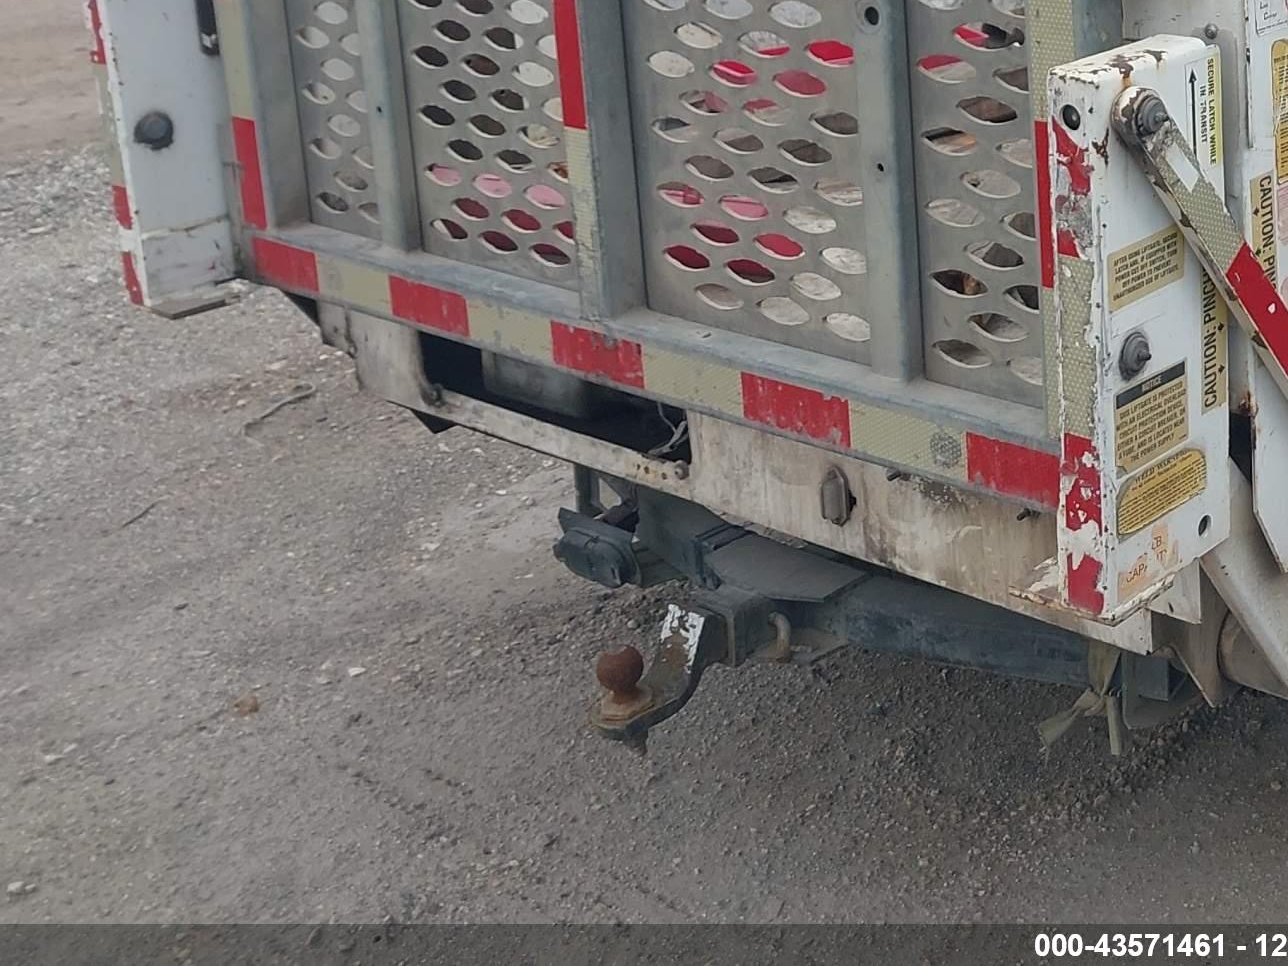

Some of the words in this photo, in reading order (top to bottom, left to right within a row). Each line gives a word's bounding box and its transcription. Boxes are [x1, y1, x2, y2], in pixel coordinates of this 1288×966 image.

[1207, 58, 1215, 96] SECURE
[1199, 85, 1207, 97] IN
[1208, 99, 1216, 131] LATCH
[1209, 133, 1217, 165] WHILE
[1259, 175, 1275, 253] CAUTION:
[1115, 271, 1130, 282] POWER
[1131, 272, 1146, 283] POWER
[1203, 326, 1217, 408] CAUTION:
[1131, 398, 1151, 414] LIFTGATE
[1137, 403, 1162, 421] ELECTRICAL
[1138, 409, 1166, 428] PROTECTION
[1137, 438, 1147, 449] AND
[1153, 424, 1173, 440] LOCATED
[1174, 417, 1185, 428] NEAR
[1140, 442, 1157, 457] POWER
